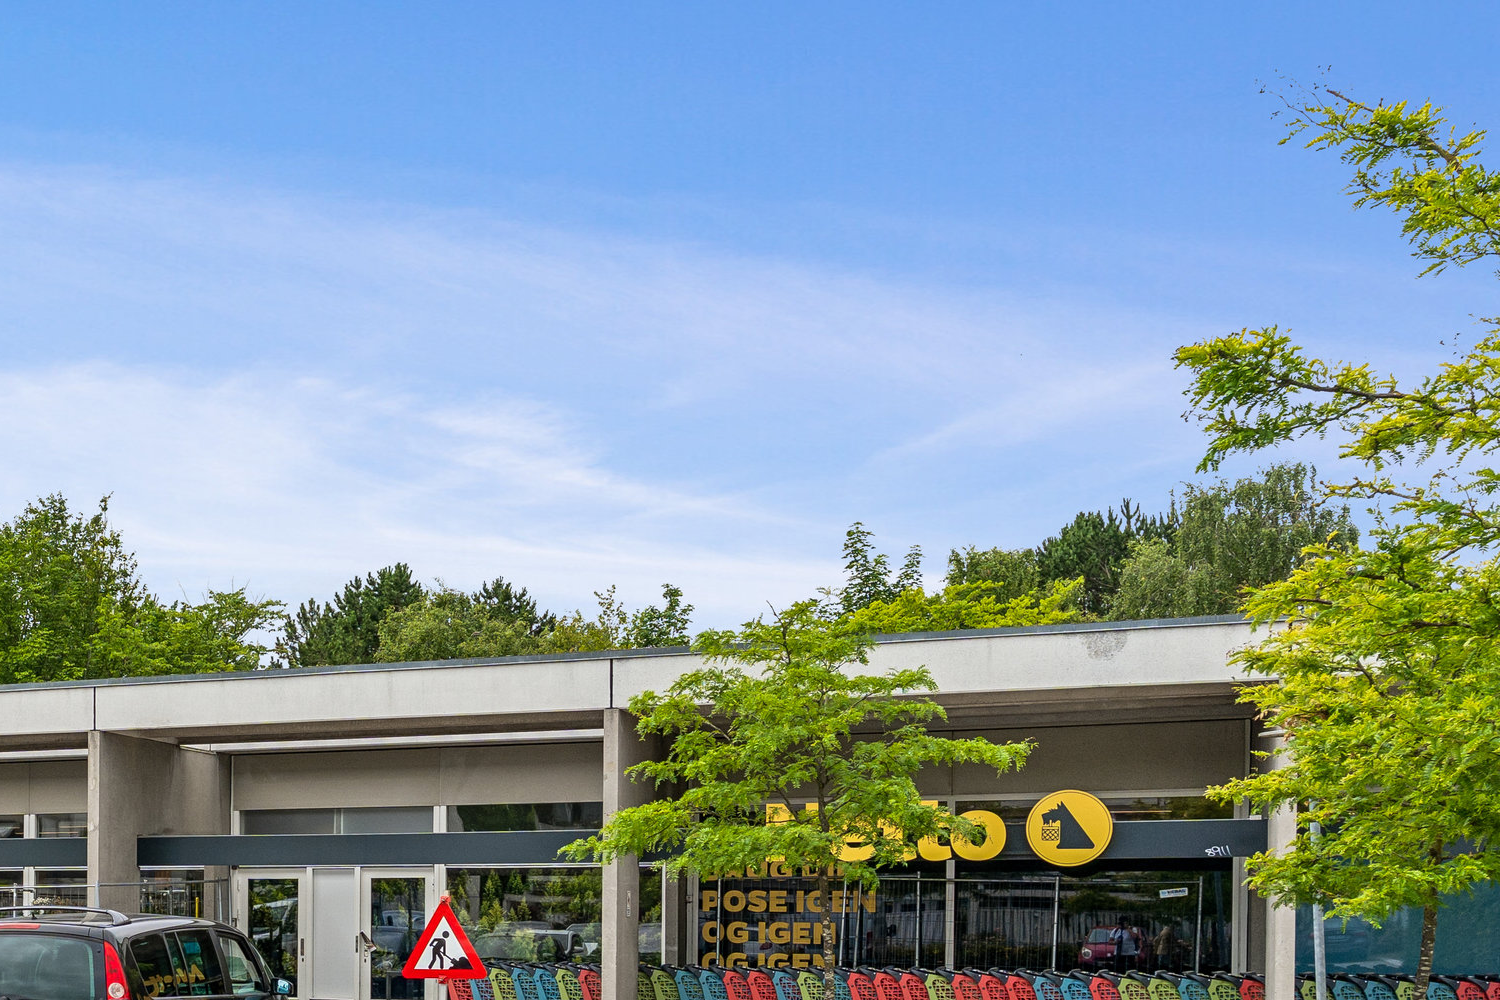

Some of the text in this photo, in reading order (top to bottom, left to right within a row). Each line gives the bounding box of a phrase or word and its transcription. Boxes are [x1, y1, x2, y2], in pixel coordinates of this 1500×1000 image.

[1205, 845, 1233, 857] 8911
[706, 860, 793, 882] UG
[702, 890, 877, 913] POSE IGEN
[702, 922, 837, 944] OG IGEN
[702, 952, 749, 968] OG
